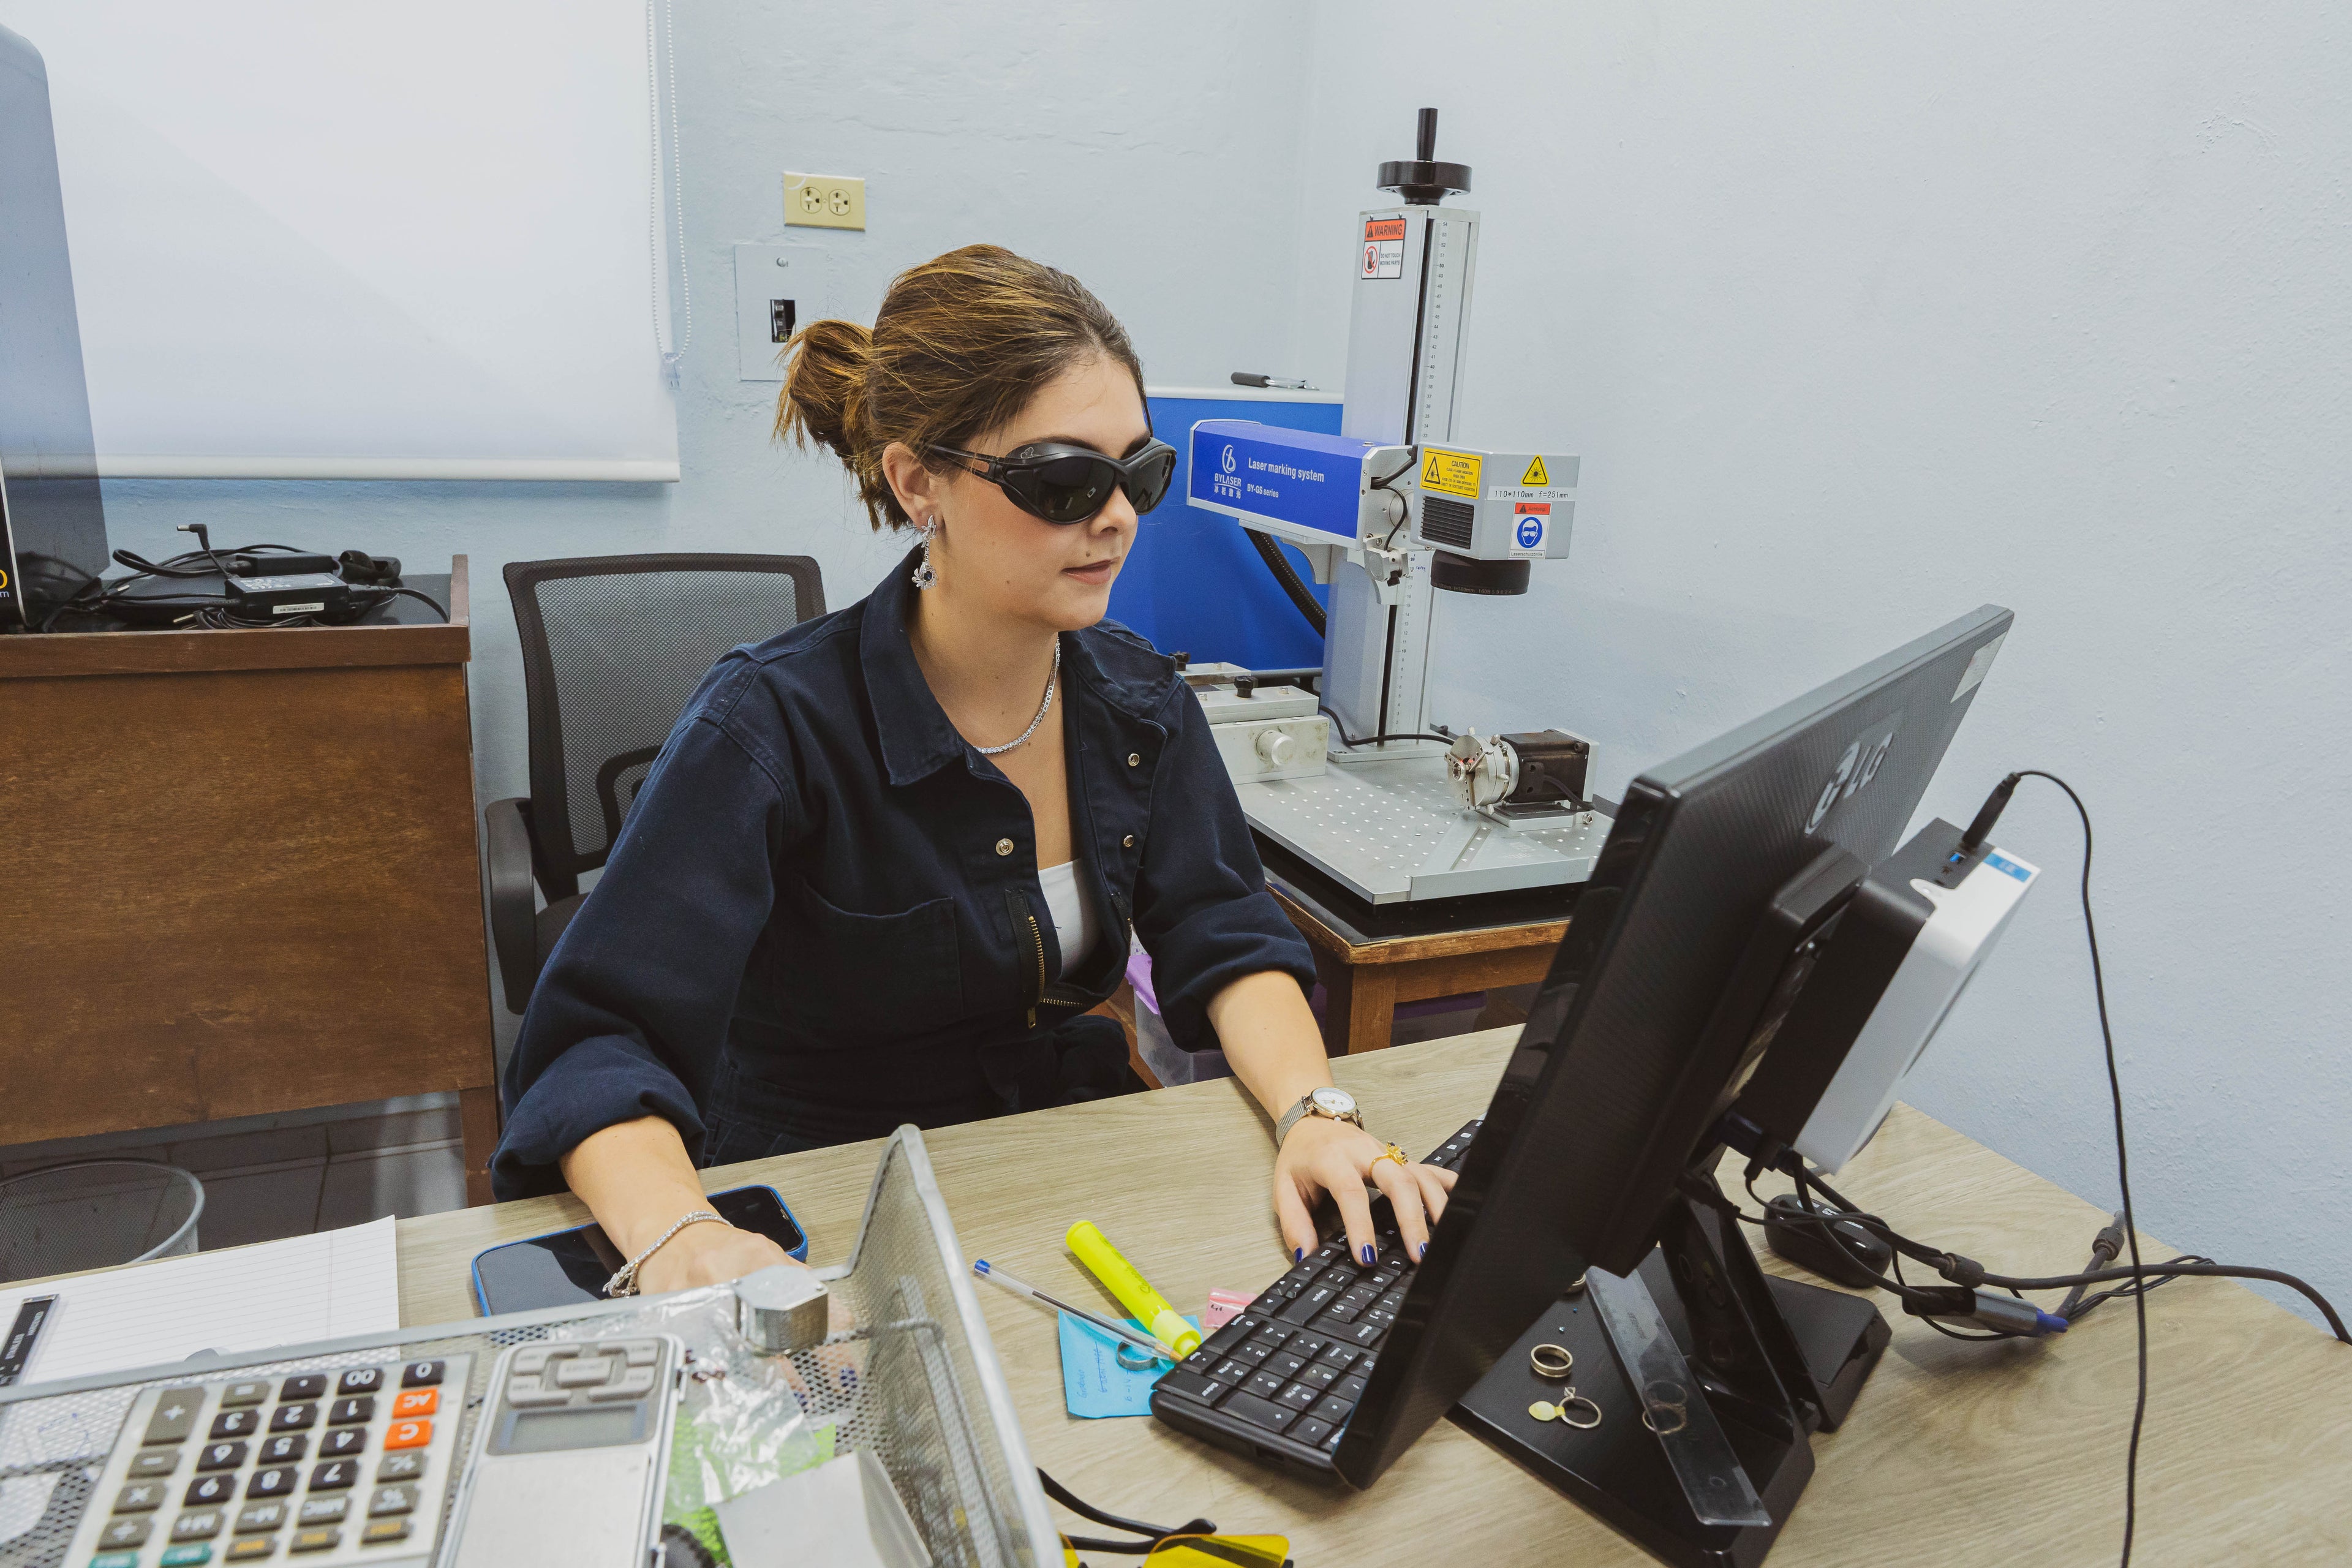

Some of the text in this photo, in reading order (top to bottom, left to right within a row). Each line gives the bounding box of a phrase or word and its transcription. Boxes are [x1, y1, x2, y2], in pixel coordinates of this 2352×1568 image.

[1375, 224, 1403, 236] WARNING
[1248, 457, 1324, 483] Laser marking system
[1451, 460, 1469, 469] CAUTION
[1215, 473, 1242, 487] BYLASER
[1246, 483, 1279, 499] BY-GS series
[346, 1370, 376, 1385] 00
[417, 1362, 432, 1378] 0
[402, 1392, 432, 1408] AC
[285, 1407, 303, 1424] 2
[347, 1401, 358, 1416] 1
[225, 1412, 243, 1430] 3
[337, 1431, 356, 1447] 4
[399, 1423, 420, 1440] C
[216, 1445, 233, 1462] 6
[275, 1438, 291, 1455] 5
[263, 1471, 279, 1490] 8
[325, 1464, 342, 1481] 7
[200, 1479, 219, 1496] 9
